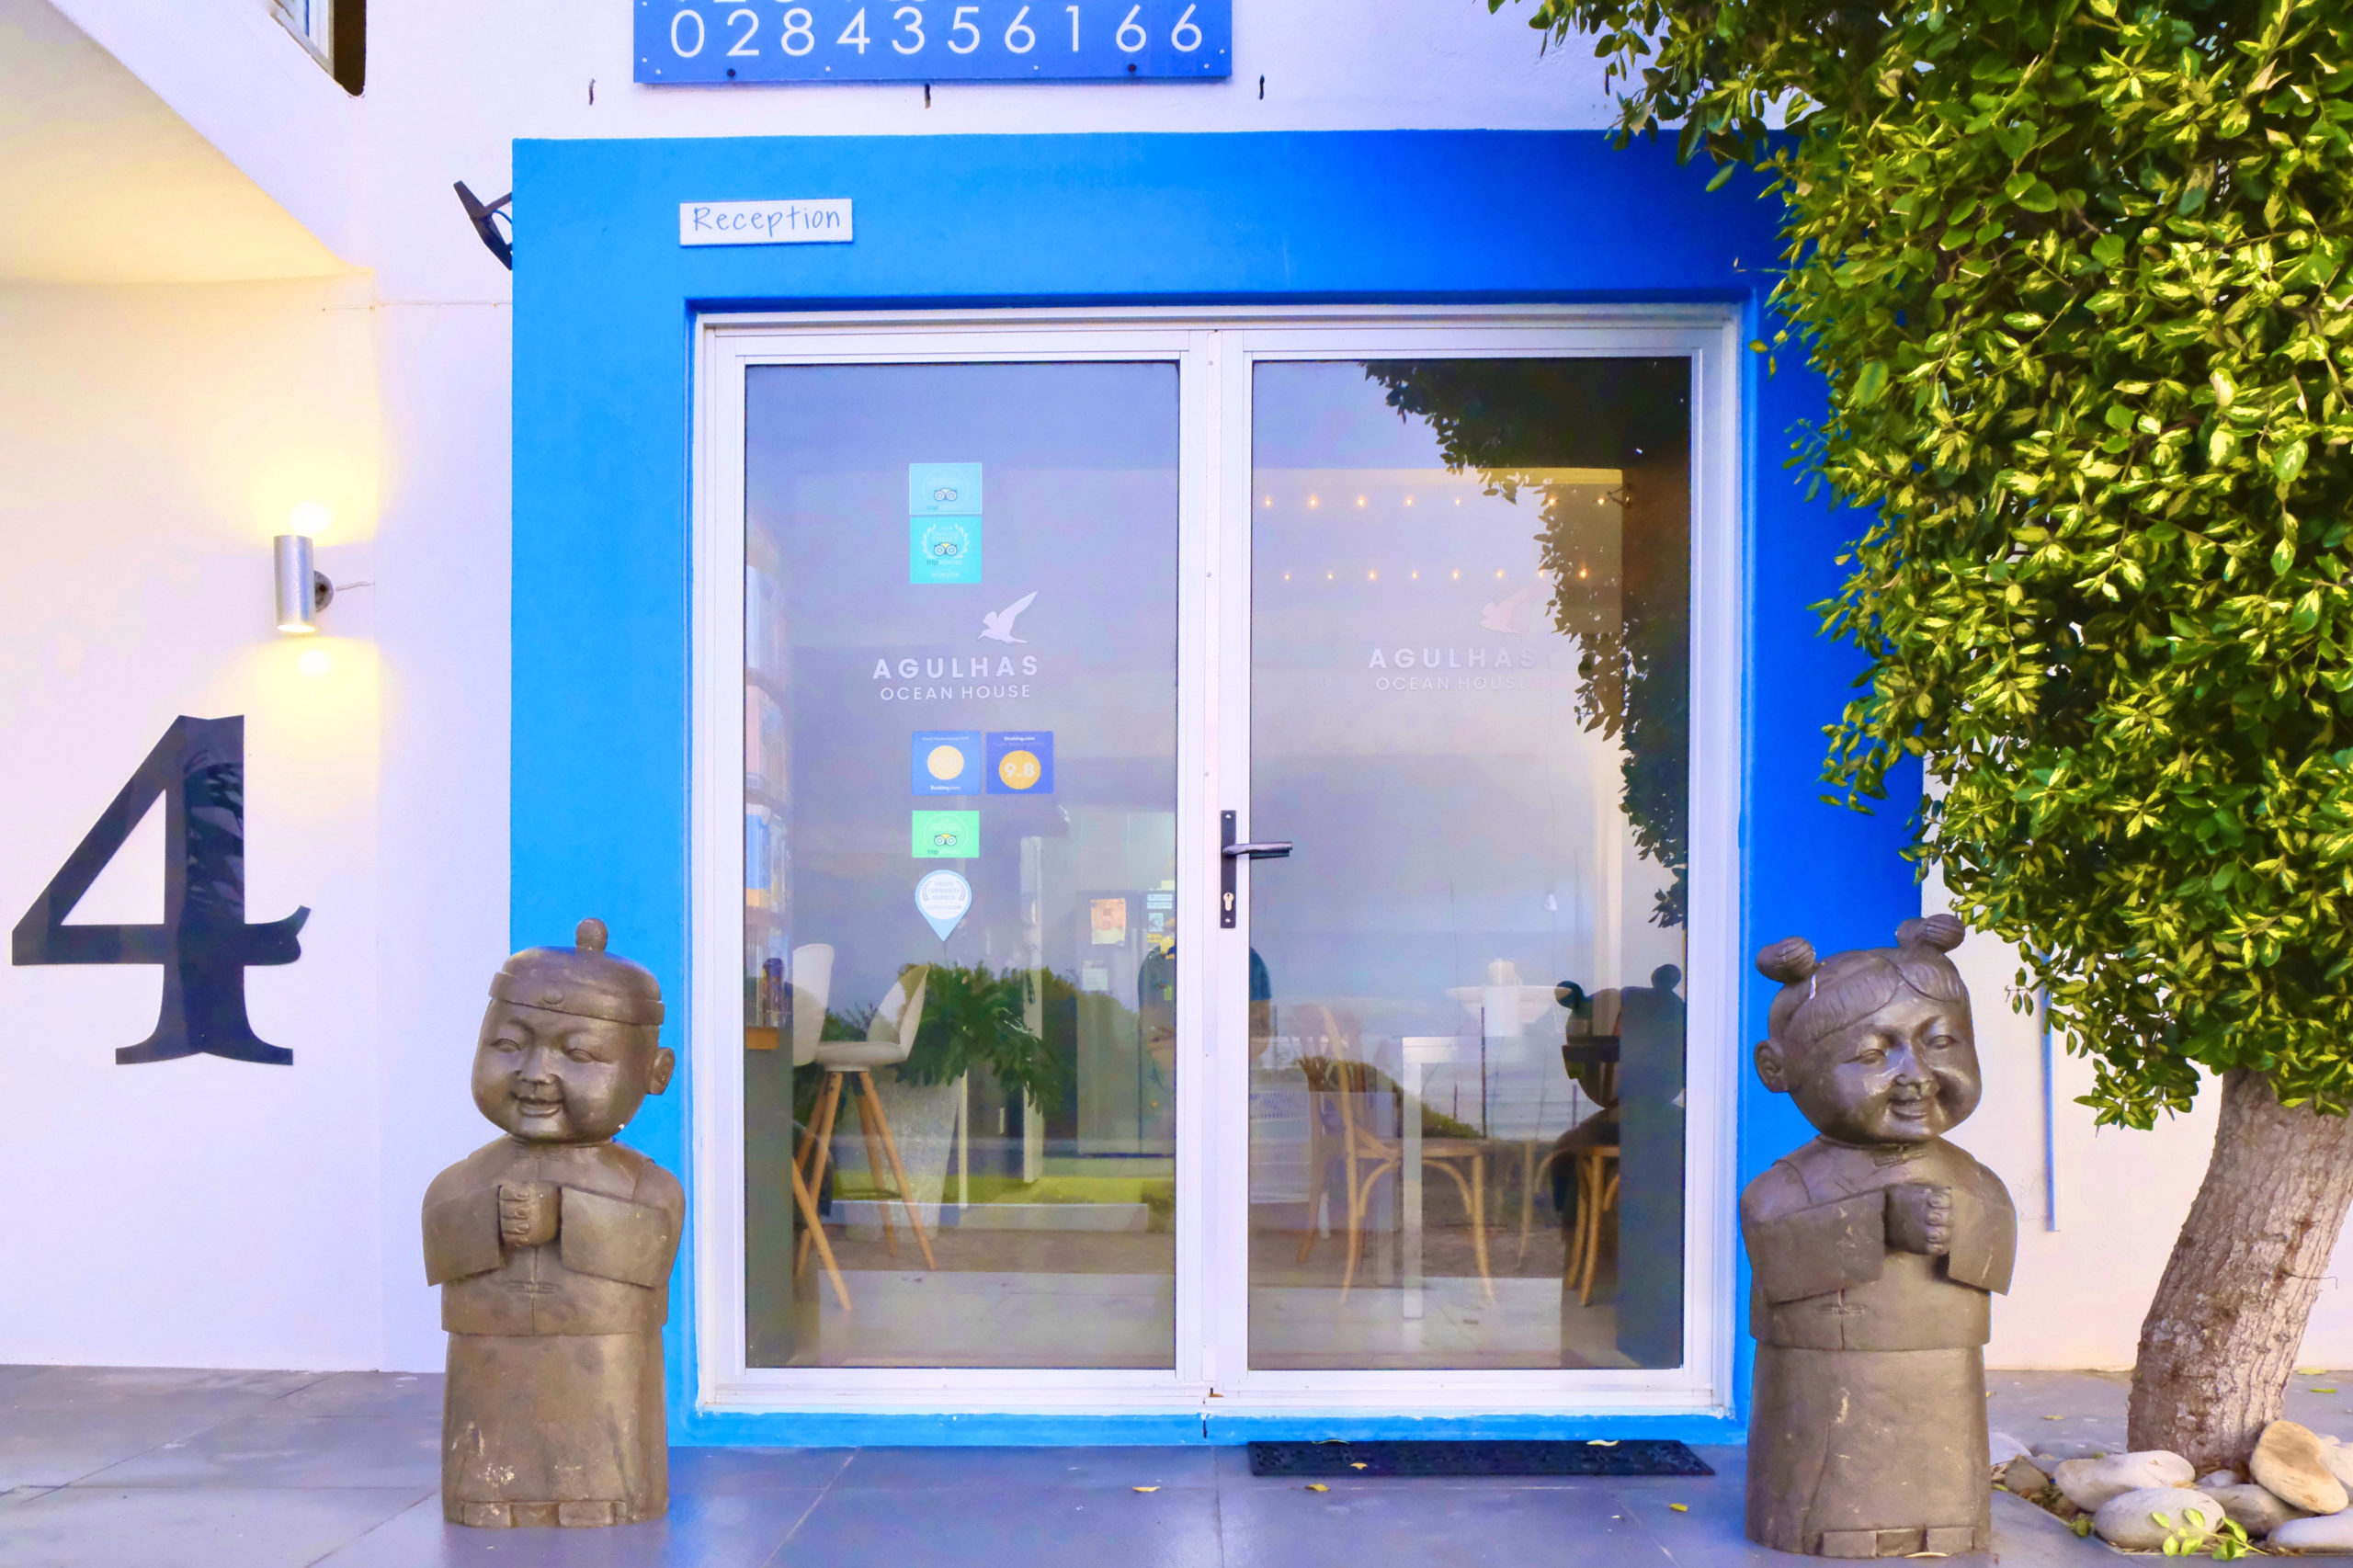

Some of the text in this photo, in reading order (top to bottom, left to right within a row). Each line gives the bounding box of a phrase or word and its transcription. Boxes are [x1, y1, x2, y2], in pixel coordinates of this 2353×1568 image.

[692, 204, 841, 238] Reception
[871, 654, 1039, 680] AGULHAS
[1367, 647, 1538, 669] AGULHAS
[880, 684, 1030, 701] OCEAN HOUSE
[1375, 676, 1449, 691] OCEAN
[1004, 762, 1036, 778] 9.8
[11, 713, 312, 1066] 4
